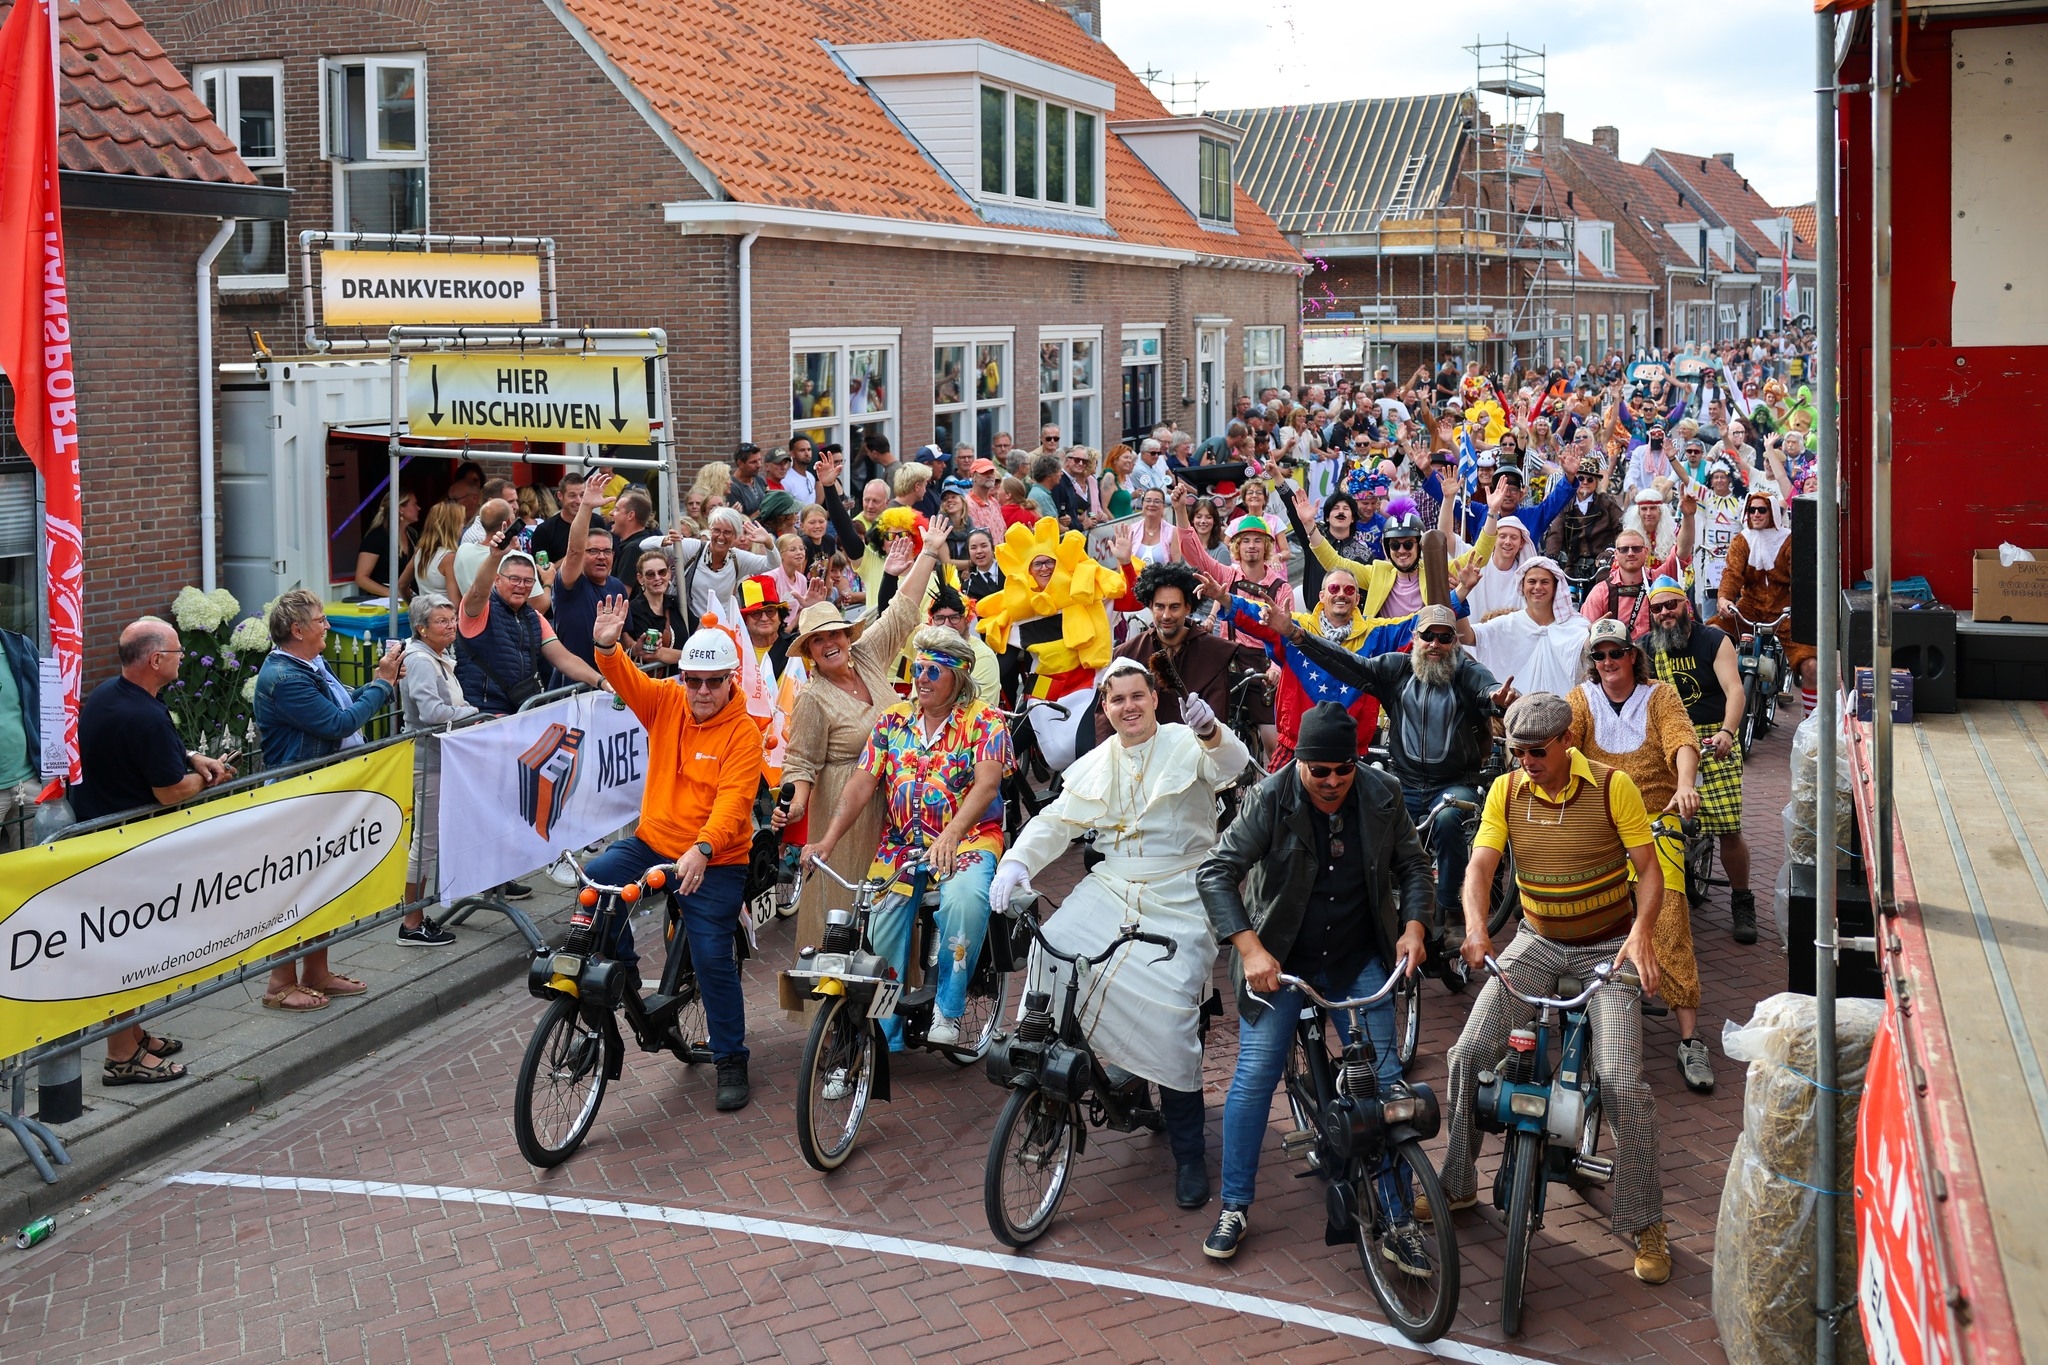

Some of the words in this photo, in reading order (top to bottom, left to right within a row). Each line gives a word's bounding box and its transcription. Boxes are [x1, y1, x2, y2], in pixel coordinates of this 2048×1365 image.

[342, 278, 525, 299] DRANKVERKOOP
[497, 368, 549, 395] HIER
[452, 400, 602, 430] INSCHRIJVEN
[689, 648, 716, 660] GEERT
[1669, 655, 1697, 672] RVANA
[597, 727, 641, 793] MBE
[10, 928, 67, 972] De
[80, 882, 182, 950] Nood
[190, 818, 384, 914] Mechanisatie
[755, 891, 772, 924] 33
[121, 904, 299, 985] www.denoodmechanisatie.nl
[874, 984, 899, 1016] 77
[1307, 1023, 1321, 1041] 4
[1569, 1047, 1577, 1058] 7
